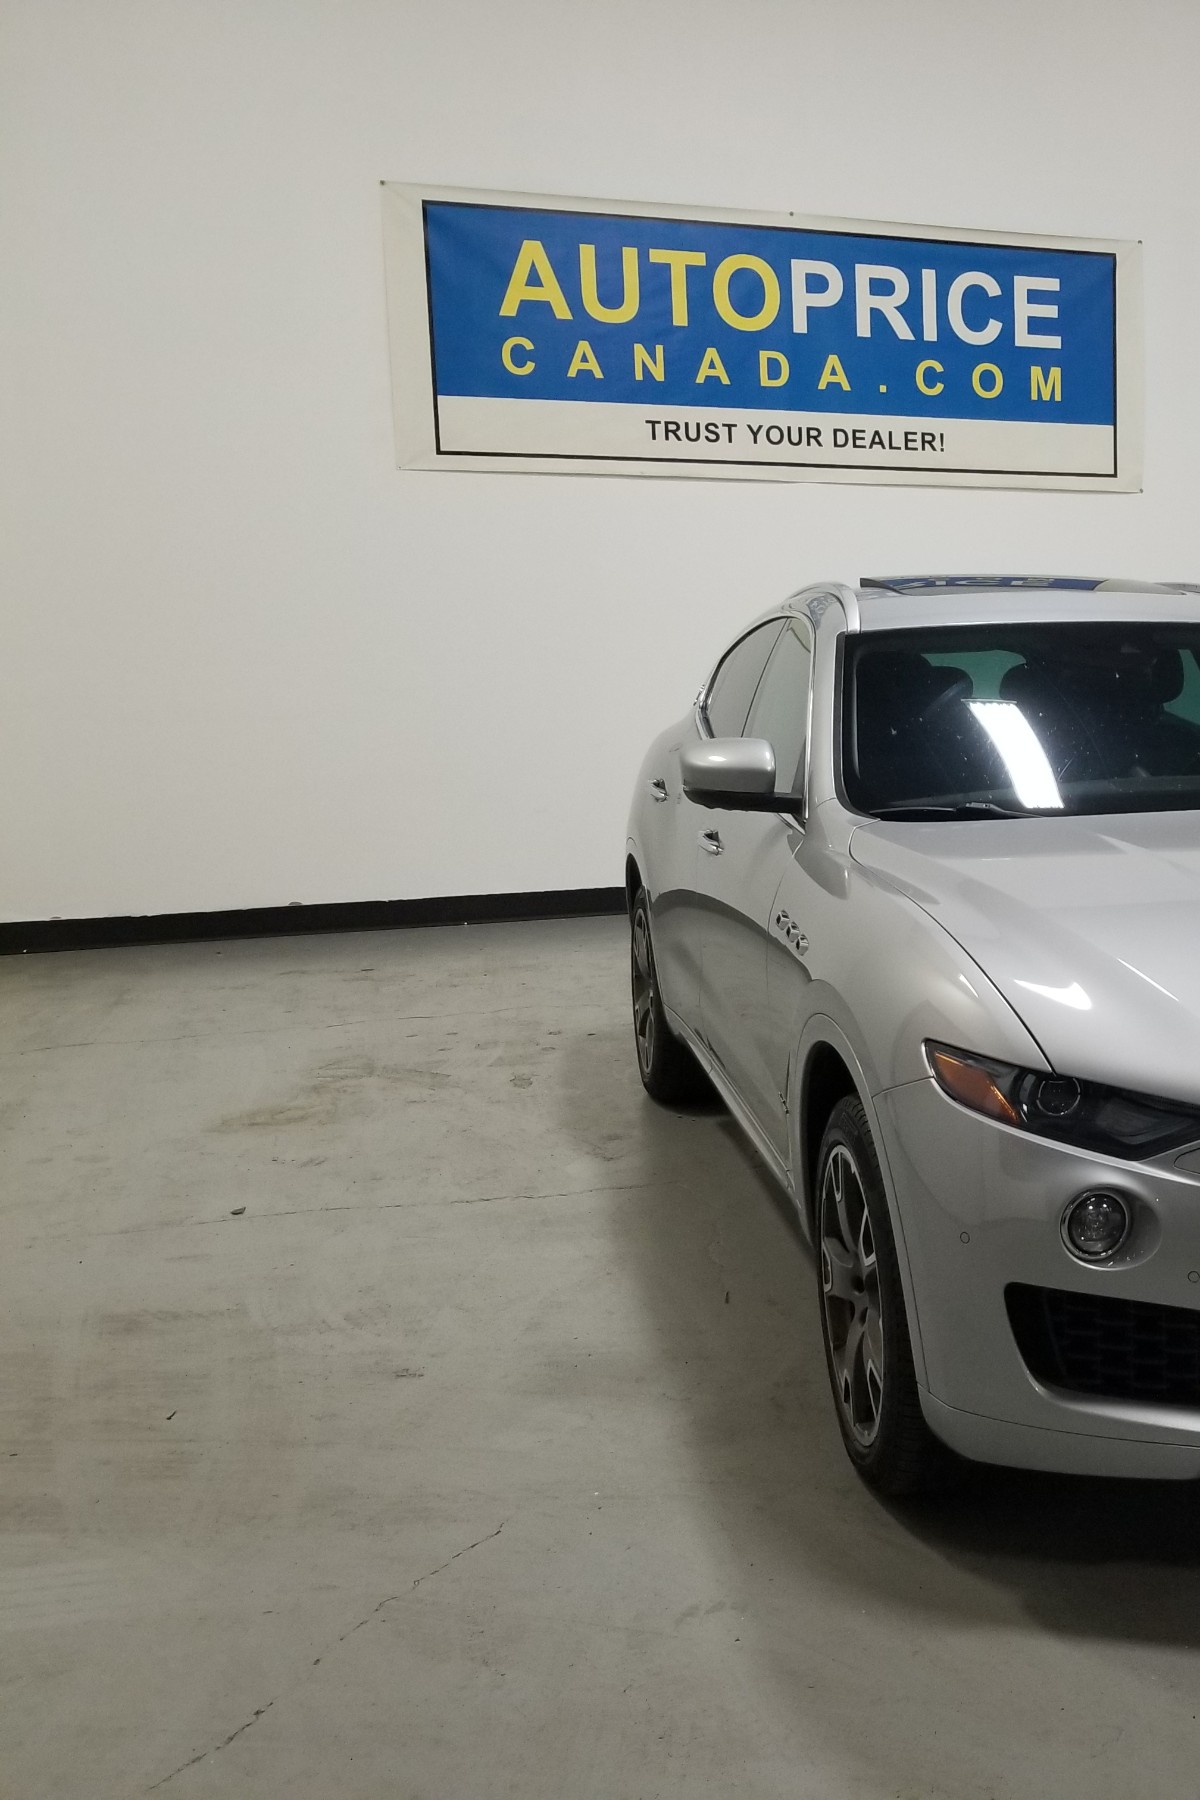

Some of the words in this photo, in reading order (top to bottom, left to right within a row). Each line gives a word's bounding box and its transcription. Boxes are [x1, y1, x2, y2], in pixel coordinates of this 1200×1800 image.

[498, 239, 1062, 349] AUTOPRICE
[501, 336, 1062, 402] CANADA.COM
[645, 419, 738, 443] TRUST
[746, 424, 823, 447] YOUR
[832, 428, 945, 452] DEALER!
